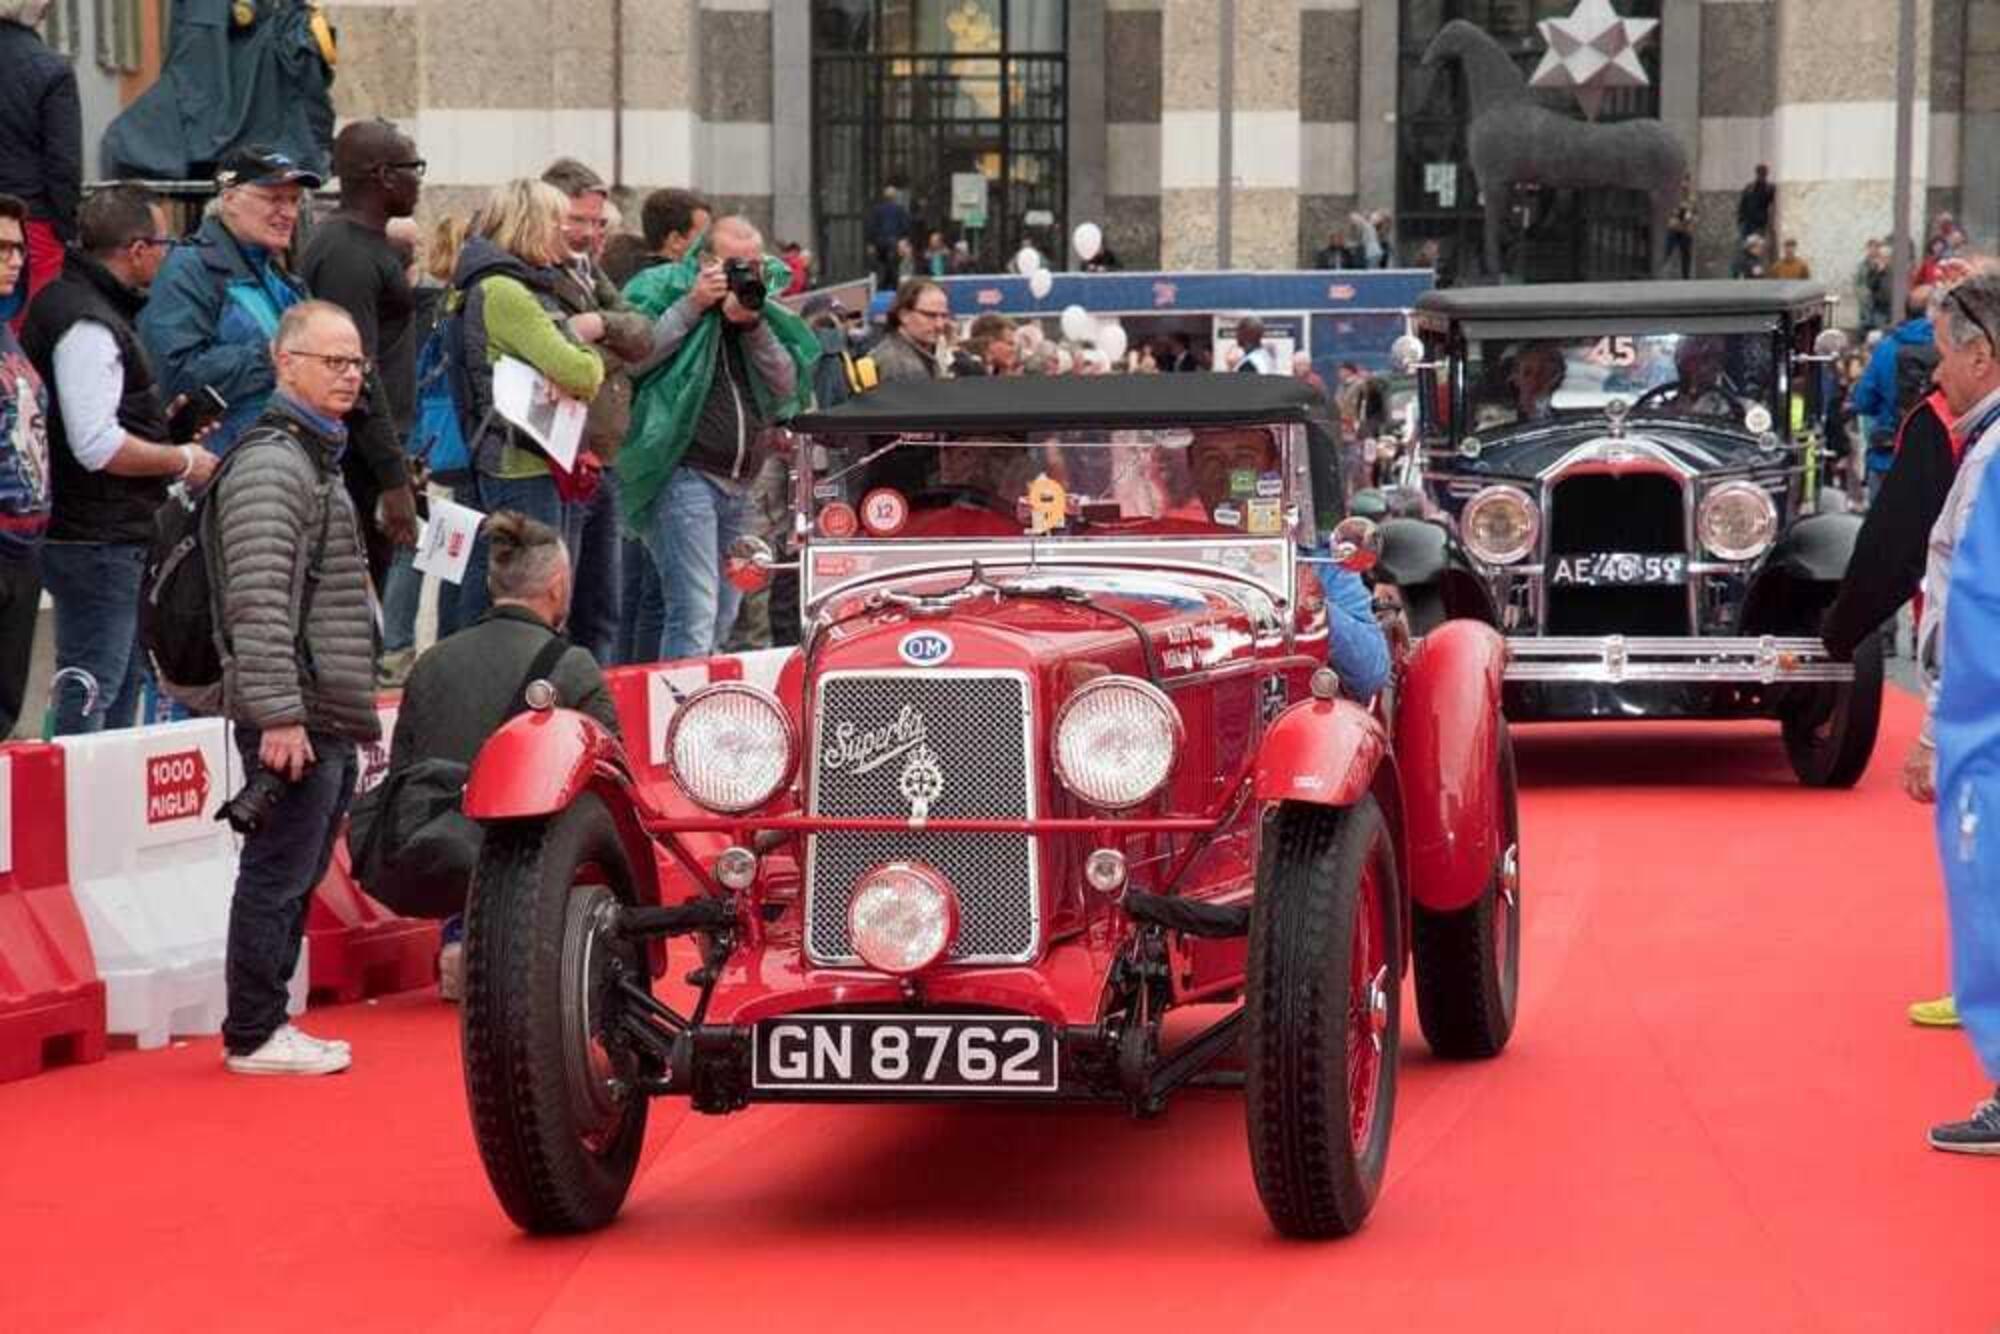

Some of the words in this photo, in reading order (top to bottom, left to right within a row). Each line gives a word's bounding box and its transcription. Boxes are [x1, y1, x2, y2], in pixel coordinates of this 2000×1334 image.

[1588, 335, 1635, 367] 45
[1553, 557, 1592, 584] AE
[908, 639, 943, 657] OM
[825, 705, 927, 772] Superba
[152, 758, 195, 786] 1000
[150, 788, 199, 819] MIGLIA
[769, 1025, 852, 1080] GN
[870, 1026, 1041, 1081] 8762
